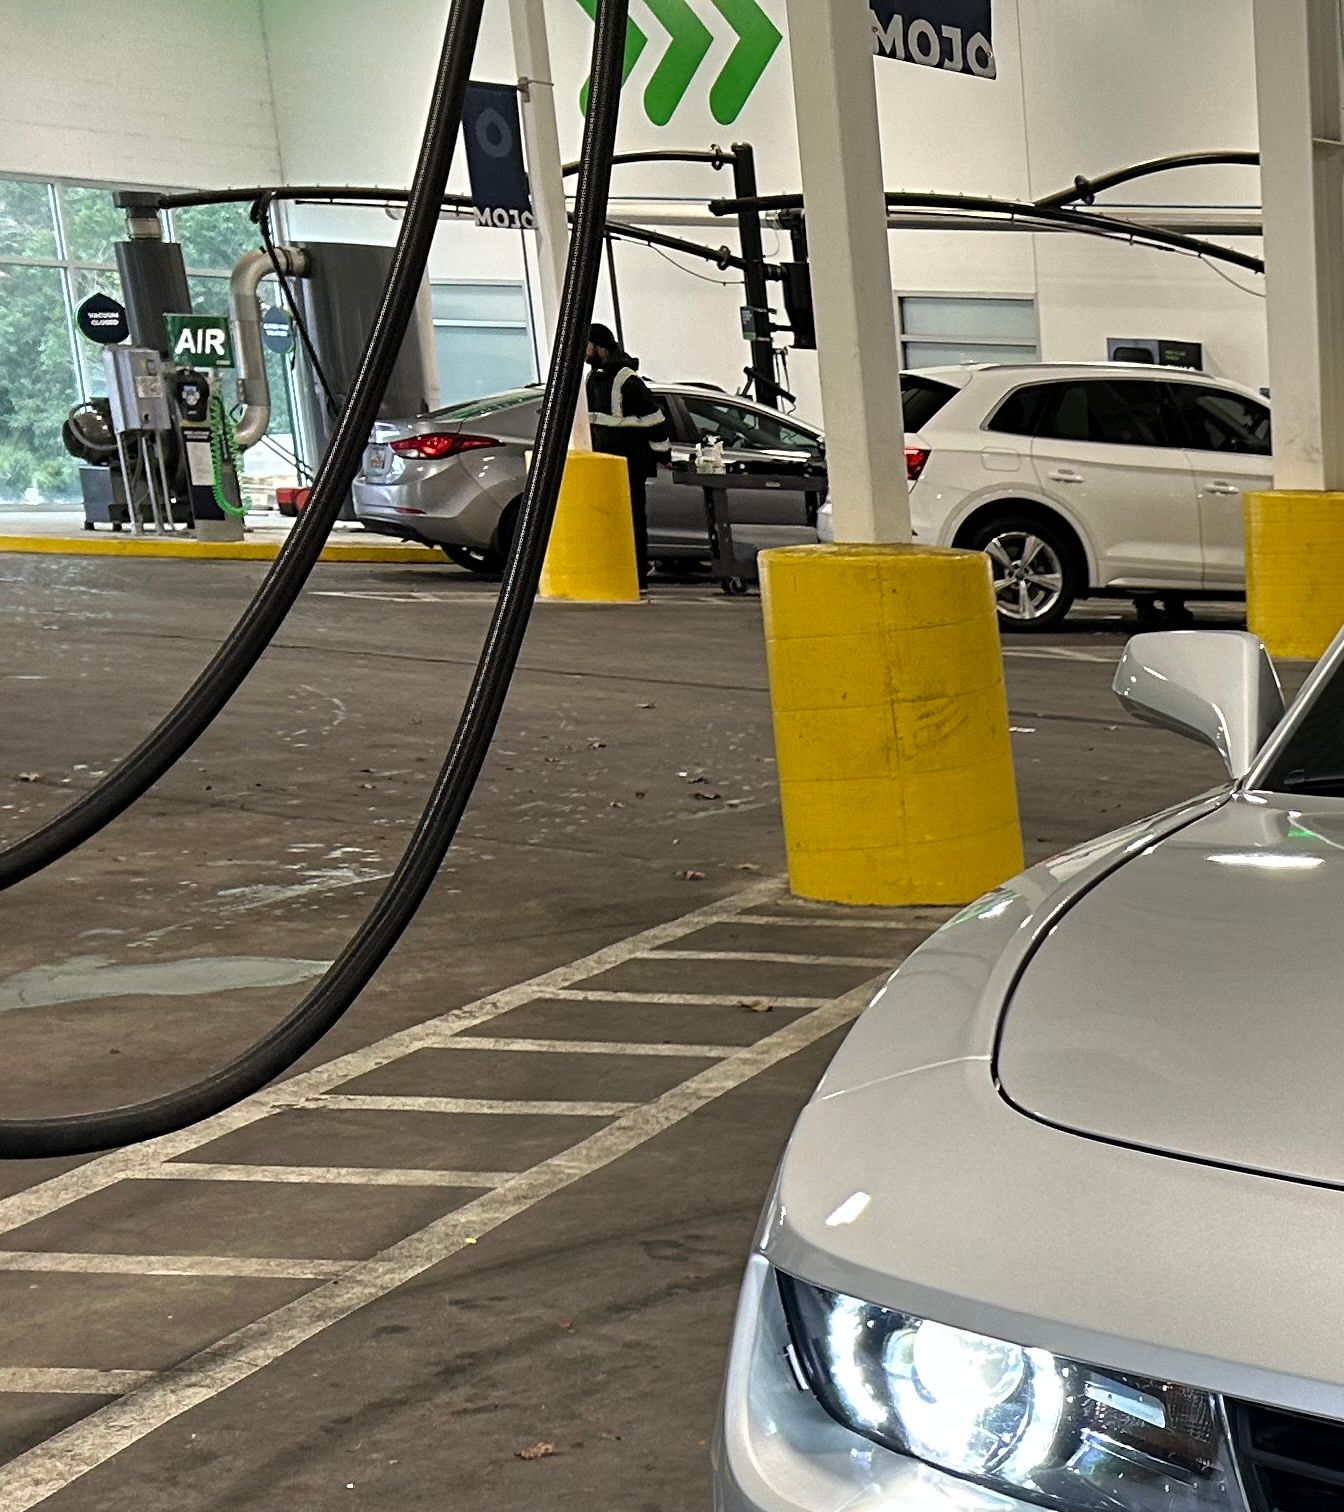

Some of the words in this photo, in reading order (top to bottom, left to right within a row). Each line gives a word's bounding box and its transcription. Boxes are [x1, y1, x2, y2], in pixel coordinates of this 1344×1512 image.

[871, 9, 996, 79] MOJO
[473, 206, 536, 229] MOJO
[175, 328, 226, 356] AIR
